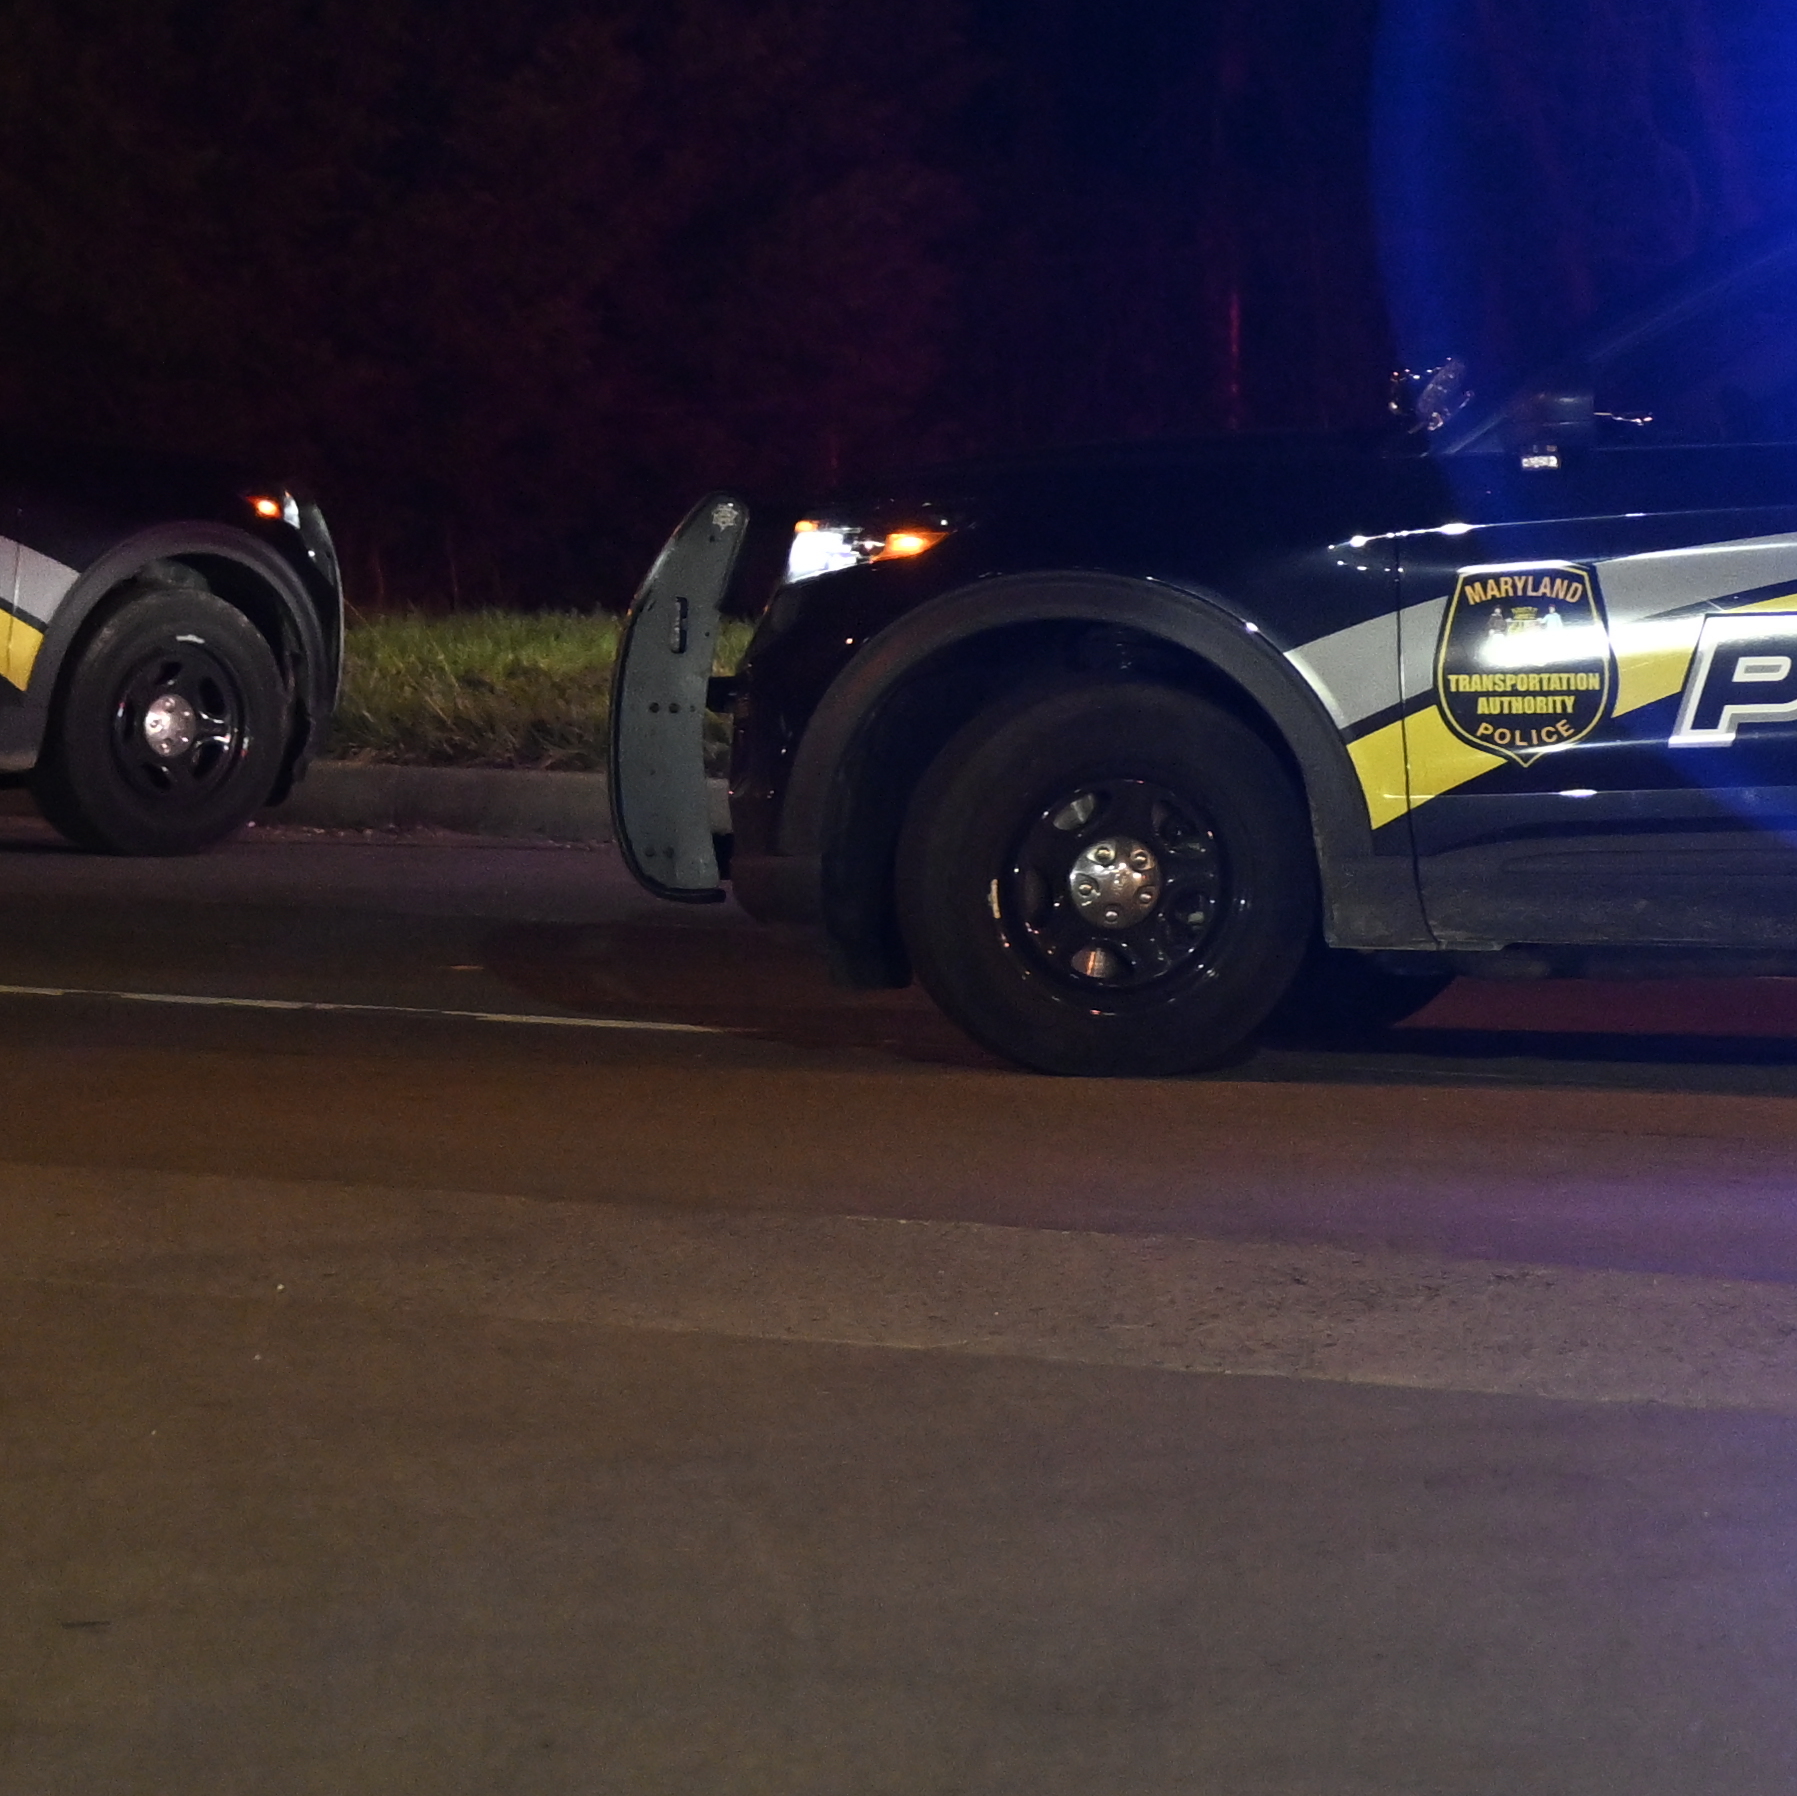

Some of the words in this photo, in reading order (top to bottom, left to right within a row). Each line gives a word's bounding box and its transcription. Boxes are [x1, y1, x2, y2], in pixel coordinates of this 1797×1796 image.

[1464, 575, 1584, 605] MARYLAND
[1448, 673, 1600, 692] TRANSPORTATION
[1477, 696, 1576, 715] AUTHORITY
[1476, 719, 1575, 746] POLICE
